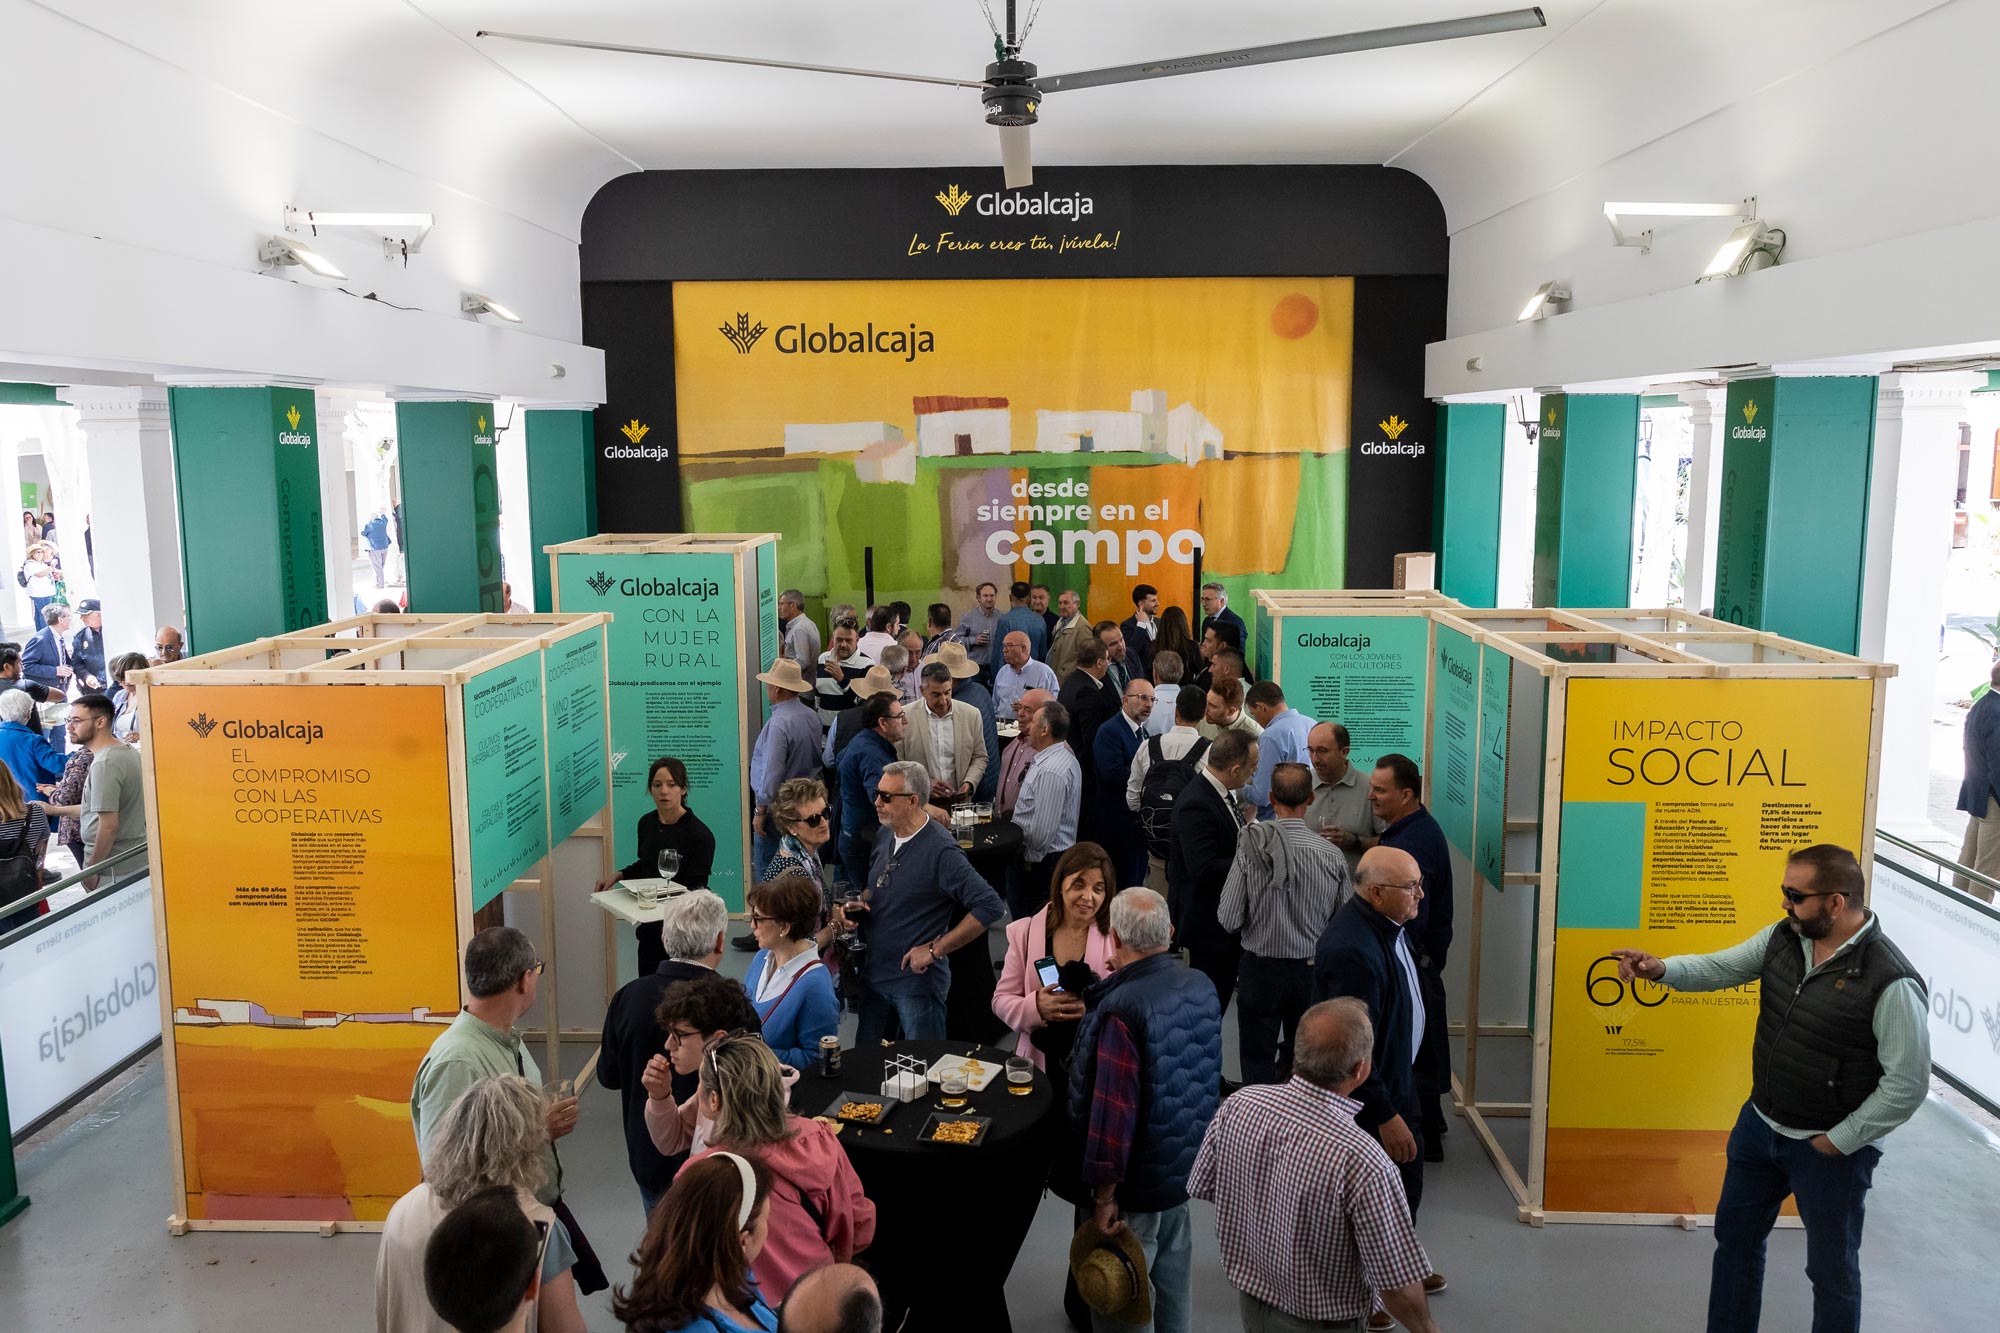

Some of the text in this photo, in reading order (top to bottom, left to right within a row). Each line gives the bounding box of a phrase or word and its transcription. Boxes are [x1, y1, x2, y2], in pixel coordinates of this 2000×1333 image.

[1161, 54, 1251, 71] MAGNOVENT
[976, 192, 1093, 221] Globalcaja
[908, 231, 1120, 256] La Feria eres tú, ¡vívela!
[774, 323, 934, 362] Globalcaja
[280, 432, 310, 449] Globalcaja
[474, 435, 492, 446] Globalcaja
[1543, 428, 1561, 440] Globalcaja
[1733, 426, 1766, 442] Globalcaja
[604, 446, 668, 461] Globalcaja
[1360, 442, 1425, 458] Globalcaja
[1011, 478, 1089, 498] desde
[977, 499, 1168, 526] siempre en el
[986, 529, 1205, 576] campo
[621, 578, 719, 602] Globalcaja
[643, 609, 720, 623] CON LA
[645, 631, 720, 645] MUJER
[1298, 633, 1370, 651] Globalcaja
[645, 653, 720, 667] RURAL
[474, 688, 490, 701] sectores
[497, 676, 517, 692] producción
[475, 683, 524, 718] COOPERATIVAS
[553, 697, 568, 716] VINO
[223, 720, 323, 744] Globalcaja
[1613, 720, 1743, 741] IMPACTO
[232, 749, 254, 762] EL
[232, 769, 370, 783] COMPROMISO
[1607, 748, 1807, 787] SOCIAL
[234, 789, 317, 803] CON LAS
[235, 809, 382, 824] COOPERATIVAS
[1671, 997, 1699, 1005] PARA
[1702, 997, 1750, 1006] NUESTRA
